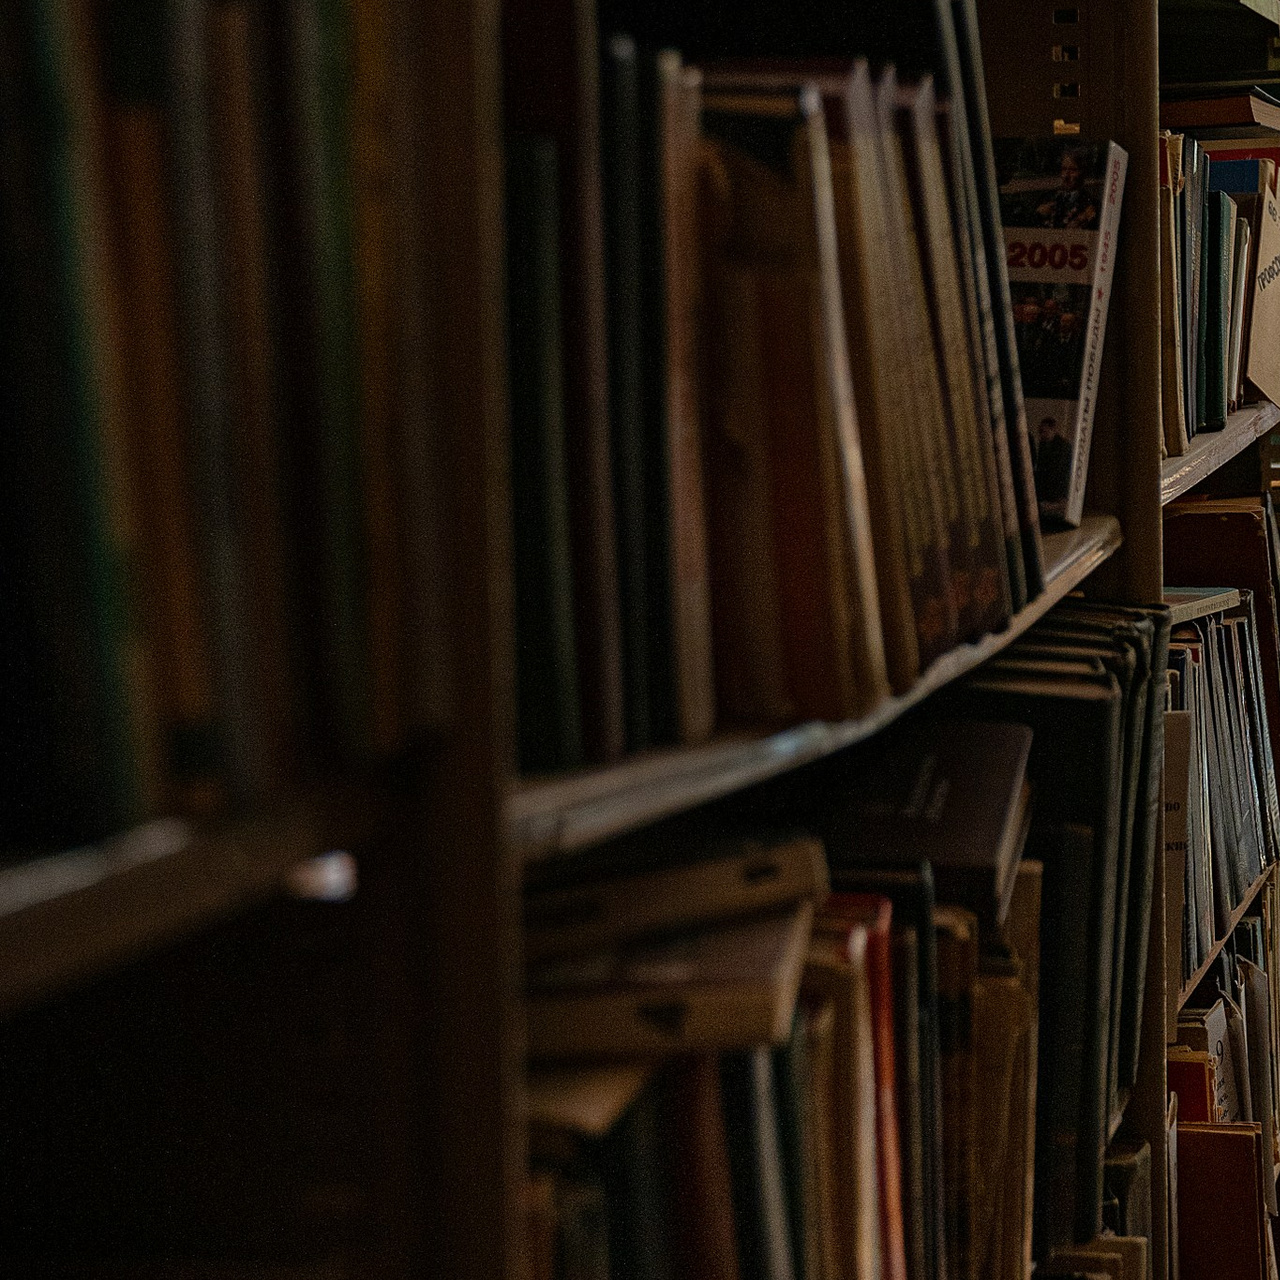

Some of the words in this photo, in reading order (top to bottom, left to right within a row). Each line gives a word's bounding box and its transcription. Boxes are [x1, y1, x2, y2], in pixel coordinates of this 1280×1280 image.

[1007, 242, 1088, 271] 2005
[1085, 308, 1102, 391] ПОБЕДЫ
[1109, 159, 1121, 206] 2005
